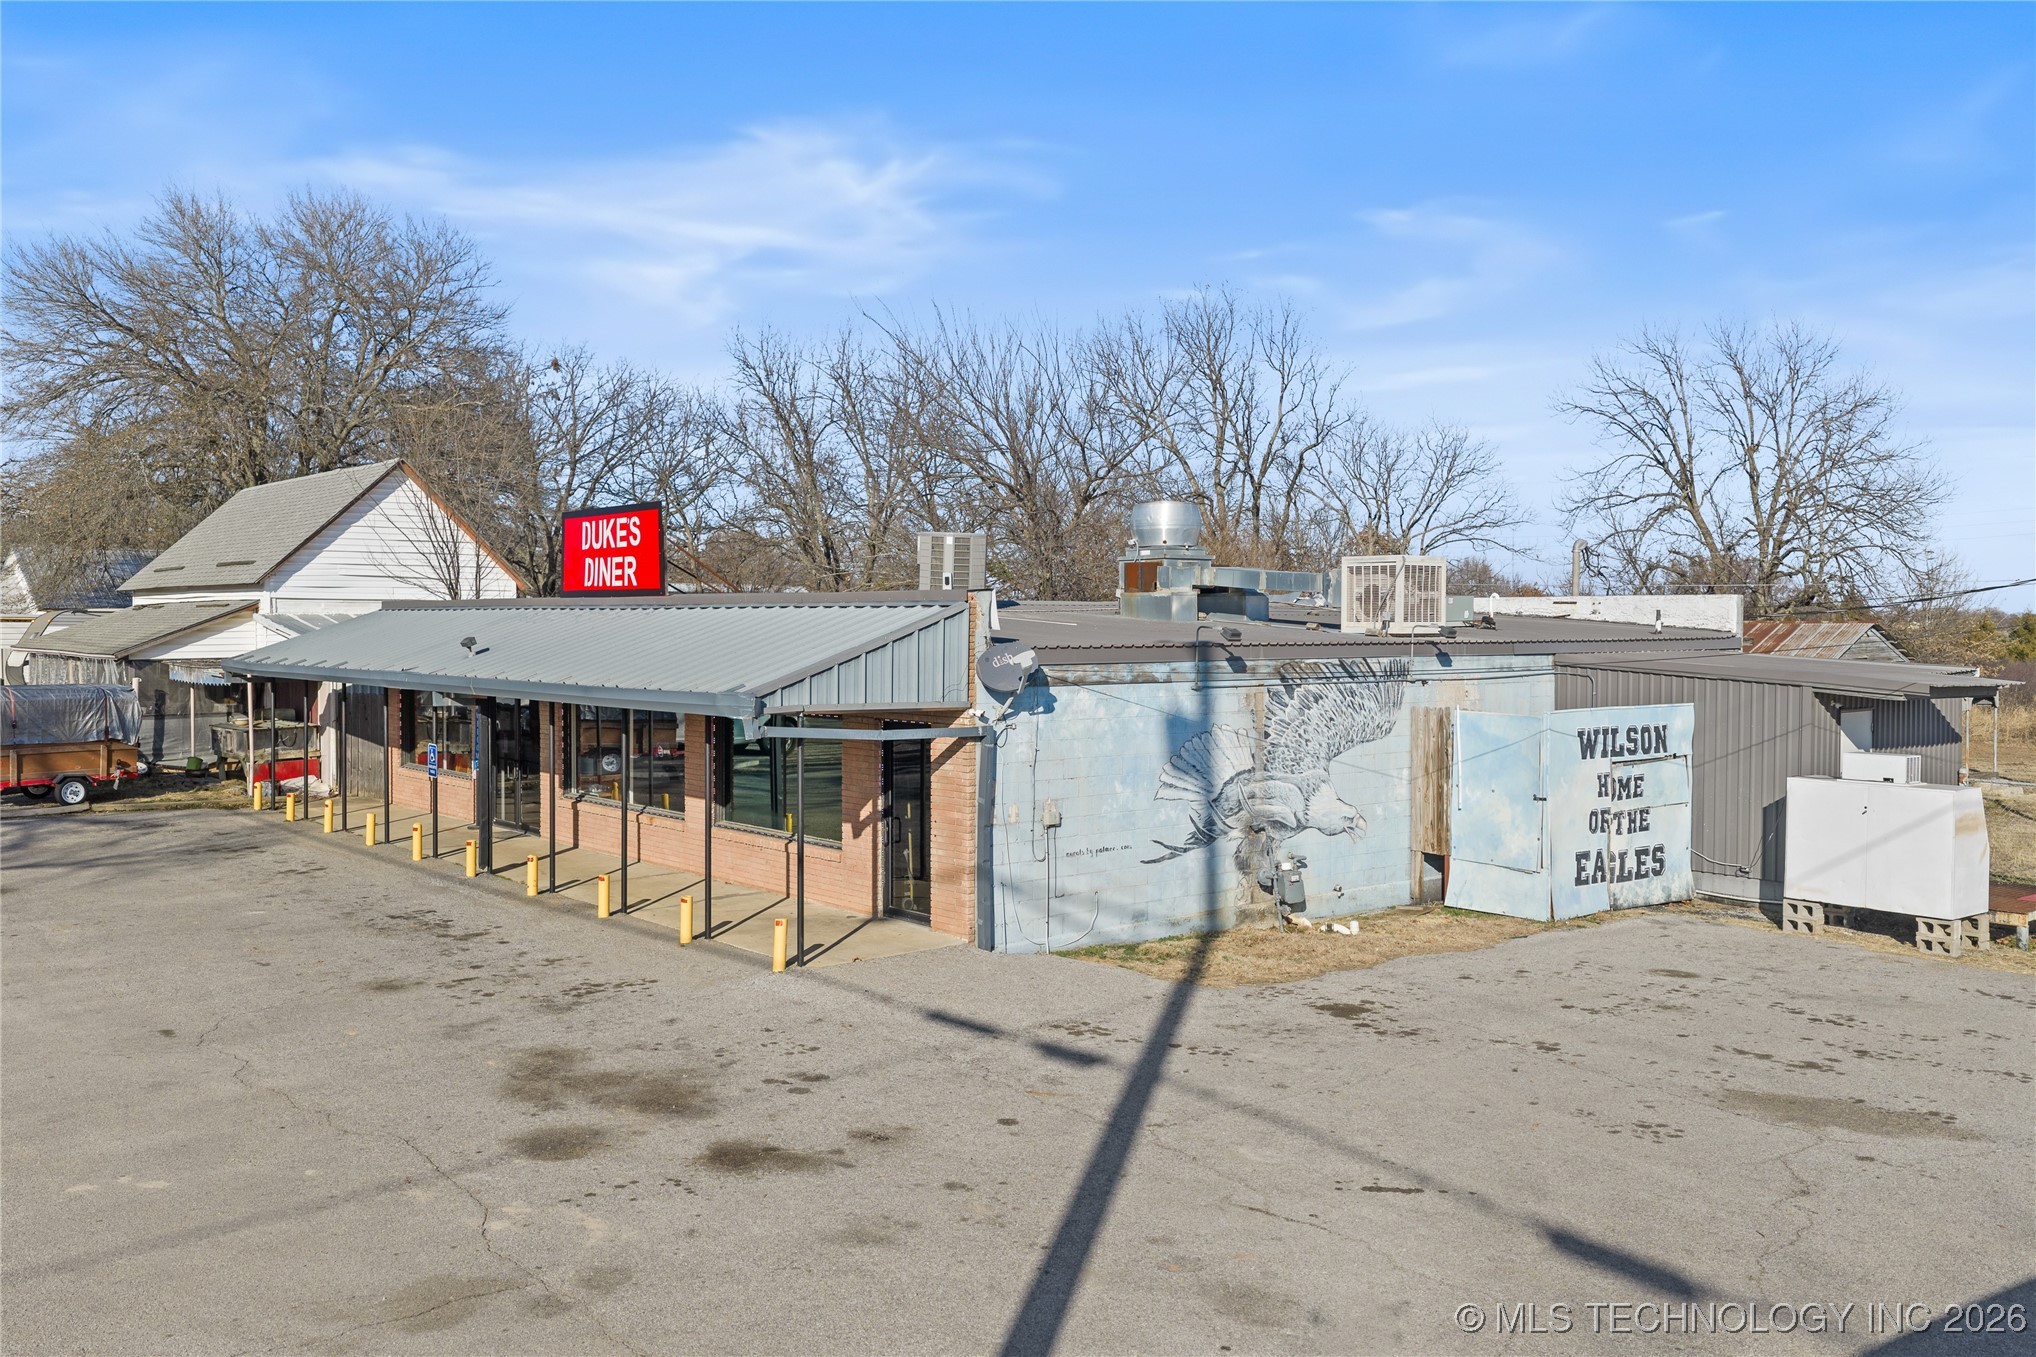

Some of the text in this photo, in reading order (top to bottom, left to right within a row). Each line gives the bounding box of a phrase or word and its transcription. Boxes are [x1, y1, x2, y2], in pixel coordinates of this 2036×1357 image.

[581, 516, 641, 550] DUKE'S
[584, 556, 638, 587] DINER
[993, 653, 1014, 668] dish
[1577, 724, 1667, 759] WILSON
[1612, 807, 1651, 836] THE
